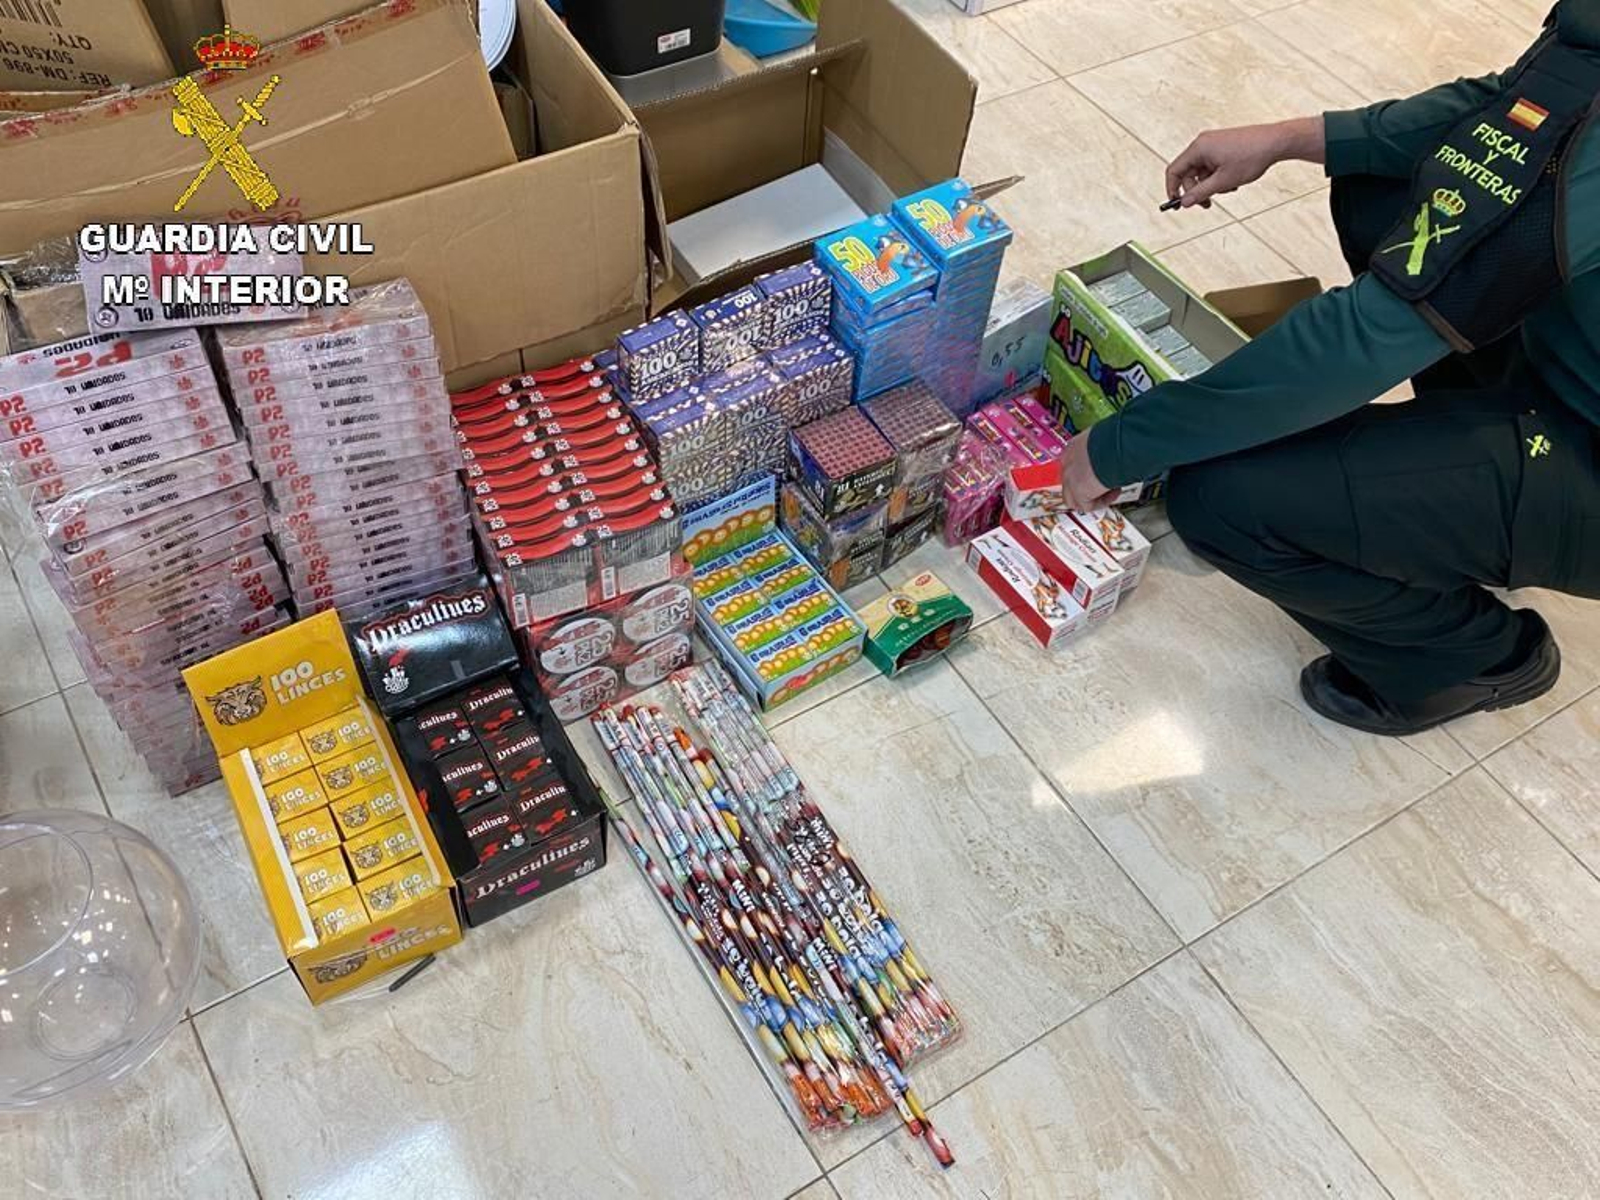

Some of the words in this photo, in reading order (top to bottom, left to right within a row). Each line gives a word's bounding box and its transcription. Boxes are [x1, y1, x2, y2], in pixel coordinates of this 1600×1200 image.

[49, 32, 92, 50] QTY:
[22, 44, 74, 64] 50X50
[73, 71, 112, 87] REF:
[1472, 122, 1530, 165] FISCAL
[1483, 150, 1500, 166] Y
[1435, 144, 1522, 205] FRONTERAS
[905, 199, 953, 230] 50
[828, 236, 876, 273] 50
[734, 290, 758, 308] 100
[774, 299, 809, 325] 100
[640, 352, 677, 379] 100
[800, 379, 832, 401] 100
[0, 395, 27, 416] P2
[9, 416, 37, 436] P2
[19, 437, 46, 458] P2
[29, 458, 57, 479] P2
[39, 479, 65, 498] P2
[671, 598, 690, 625] 25
[367, 595, 487, 655] Draculines
[270, 661, 314, 692] 100
[275, 668, 347, 706] LINCES
[469, 686, 514, 711] Draculin
[338, 722, 360, 737] 100
[419, 710, 458, 730] culines
[342, 726, 372, 744] LINCE
[496, 734, 541, 762] Draculin
[266, 751, 288, 767] 100
[354, 756, 376, 772] 100
[442, 761, 484, 783] culines
[281, 788, 304, 803] 100
[370, 793, 393, 810] 100
[520, 785, 567, 812] Draculin
[375, 799, 400, 816] LINC
[293, 827, 317, 843] 100
[467, 814, 510, 839] culines
[384, 833, 406, 849] 100
[388, 837, 419, 857] LINCE
[305, 869, 328, 885] 100
[475, 836, 590, 899] Draculines
[399, 874, 422, 891] 100
[323, 908, 346, 925] 100
